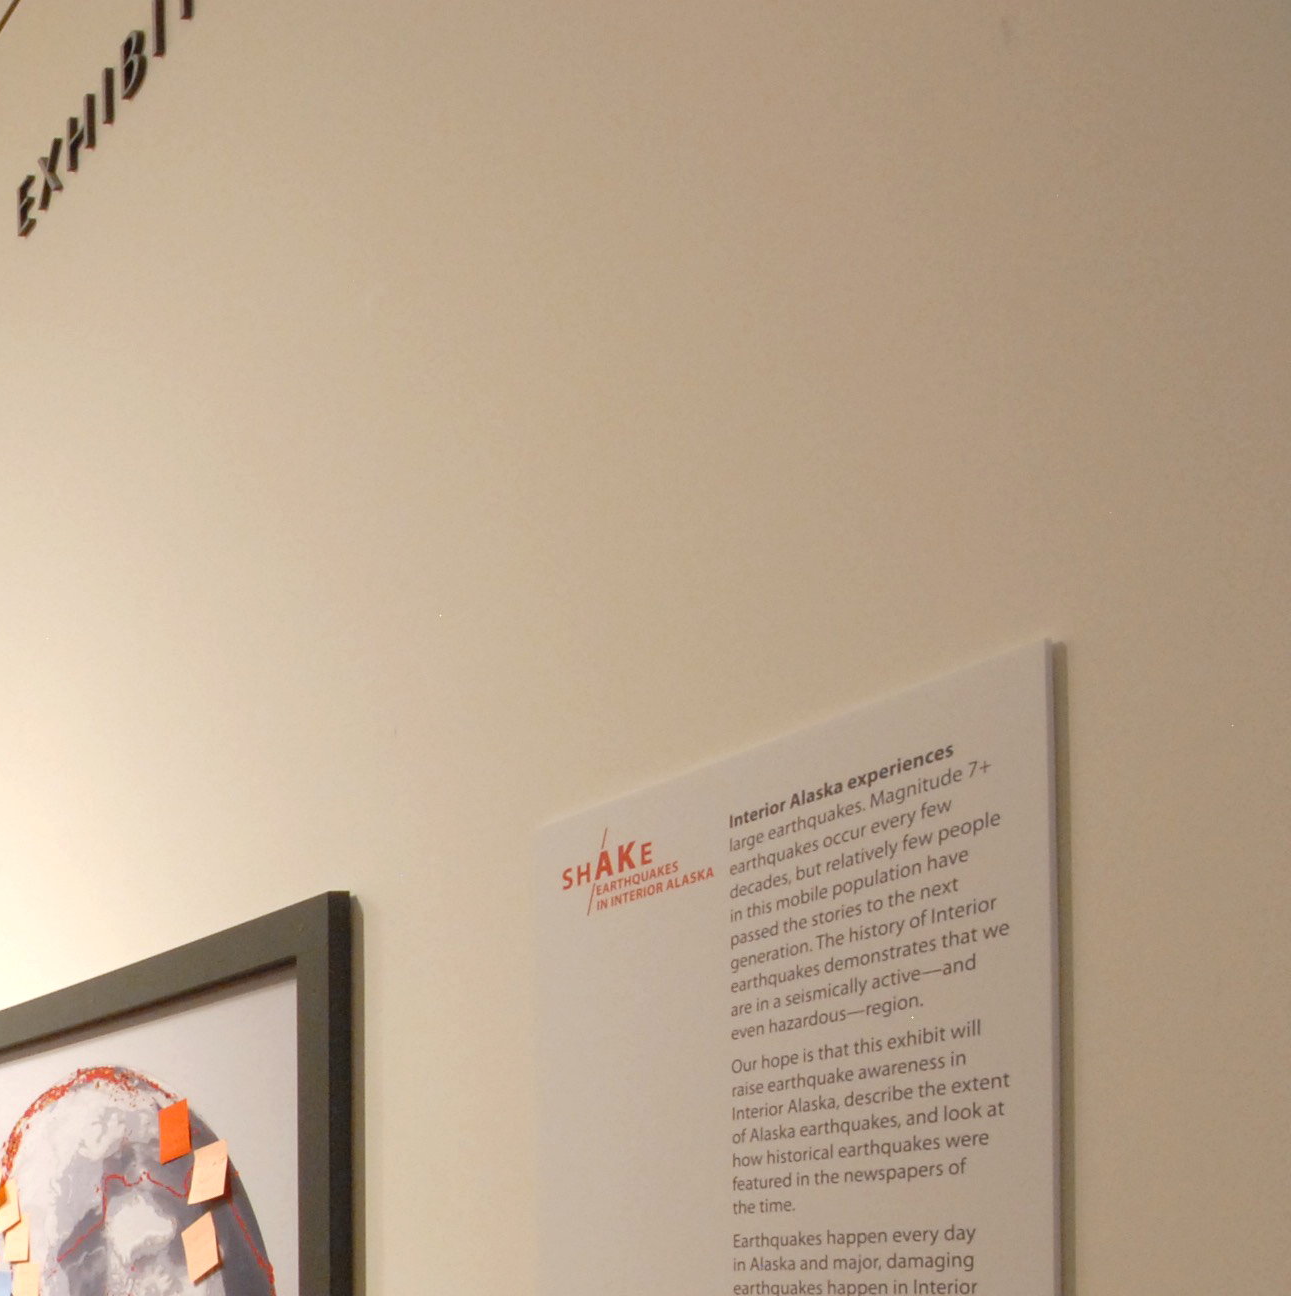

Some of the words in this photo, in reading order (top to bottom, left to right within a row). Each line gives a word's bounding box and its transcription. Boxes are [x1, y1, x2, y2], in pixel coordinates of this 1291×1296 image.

[730, 801, 786, 828] Interior
[790, 782, 843, 808] Alaska
[848, 745, 953, 789] experiences
[730, 833, 764, 851] large
[768, 801, 865, 840] earthquakes.
[870, 769, 962, 808] Magnitude
[969, 761, 990, 778] 7+
[730, 840, 819, 875] earthquakes
[823, 825, 866, 848] occur
[871, 811, 916, 834] every
[921, 800, 951, 819] few
[730, 874, 791, 899] decades,
[796, 863, 821, 880] but
[826, 841, 898, 872] relatively
[903, 833, 933, 851] few
[939, 814, 1000, 846] people
[562, 841, 653, 890] SHAKE
[596, 861, 679, 896] EARTHQUAKES
[597, 898, 608, 910] IN
[611, 882, 664, 906] INTERIOR
[666, 867, 714, 891] ALASKA
[731, 964, 820, 993] earthquakes
[824, 939, 936, 973] demonstrates
[942, 929, 977, 948] that
[983, 923, 1009, 939] we
[732, 1083, 763, 1097] raise
[768, 1068, 854, 1092] earthquake
[858, 1057, 945, 1080] awareness
[951, 1051, 966, 1066] in
[733, 1105, 783, 1120] Interior
[788, 1095, 839, 1113] Alaska,
[844, 1085, 913, 1107] describe
[918, 1081, 946, 1098] the
[951, 1073, 1009, 1093] extent
[733, 1153, 762, 1167] how
[767, 1144, 833, 1164] historical
[838, 1136, 940, 1158] earthquakes
[946, 1133, 989, 1148] were
[734, 1232, 822, 1250] Earthquakes
[827, 1230, 887, 1248] happen
[893, 1230, 939, 1246] every
[944, 1225, 976, 1244] day
[894, 1280, 908, 1294] in
[914, 1279, 977, 1295] Interior
